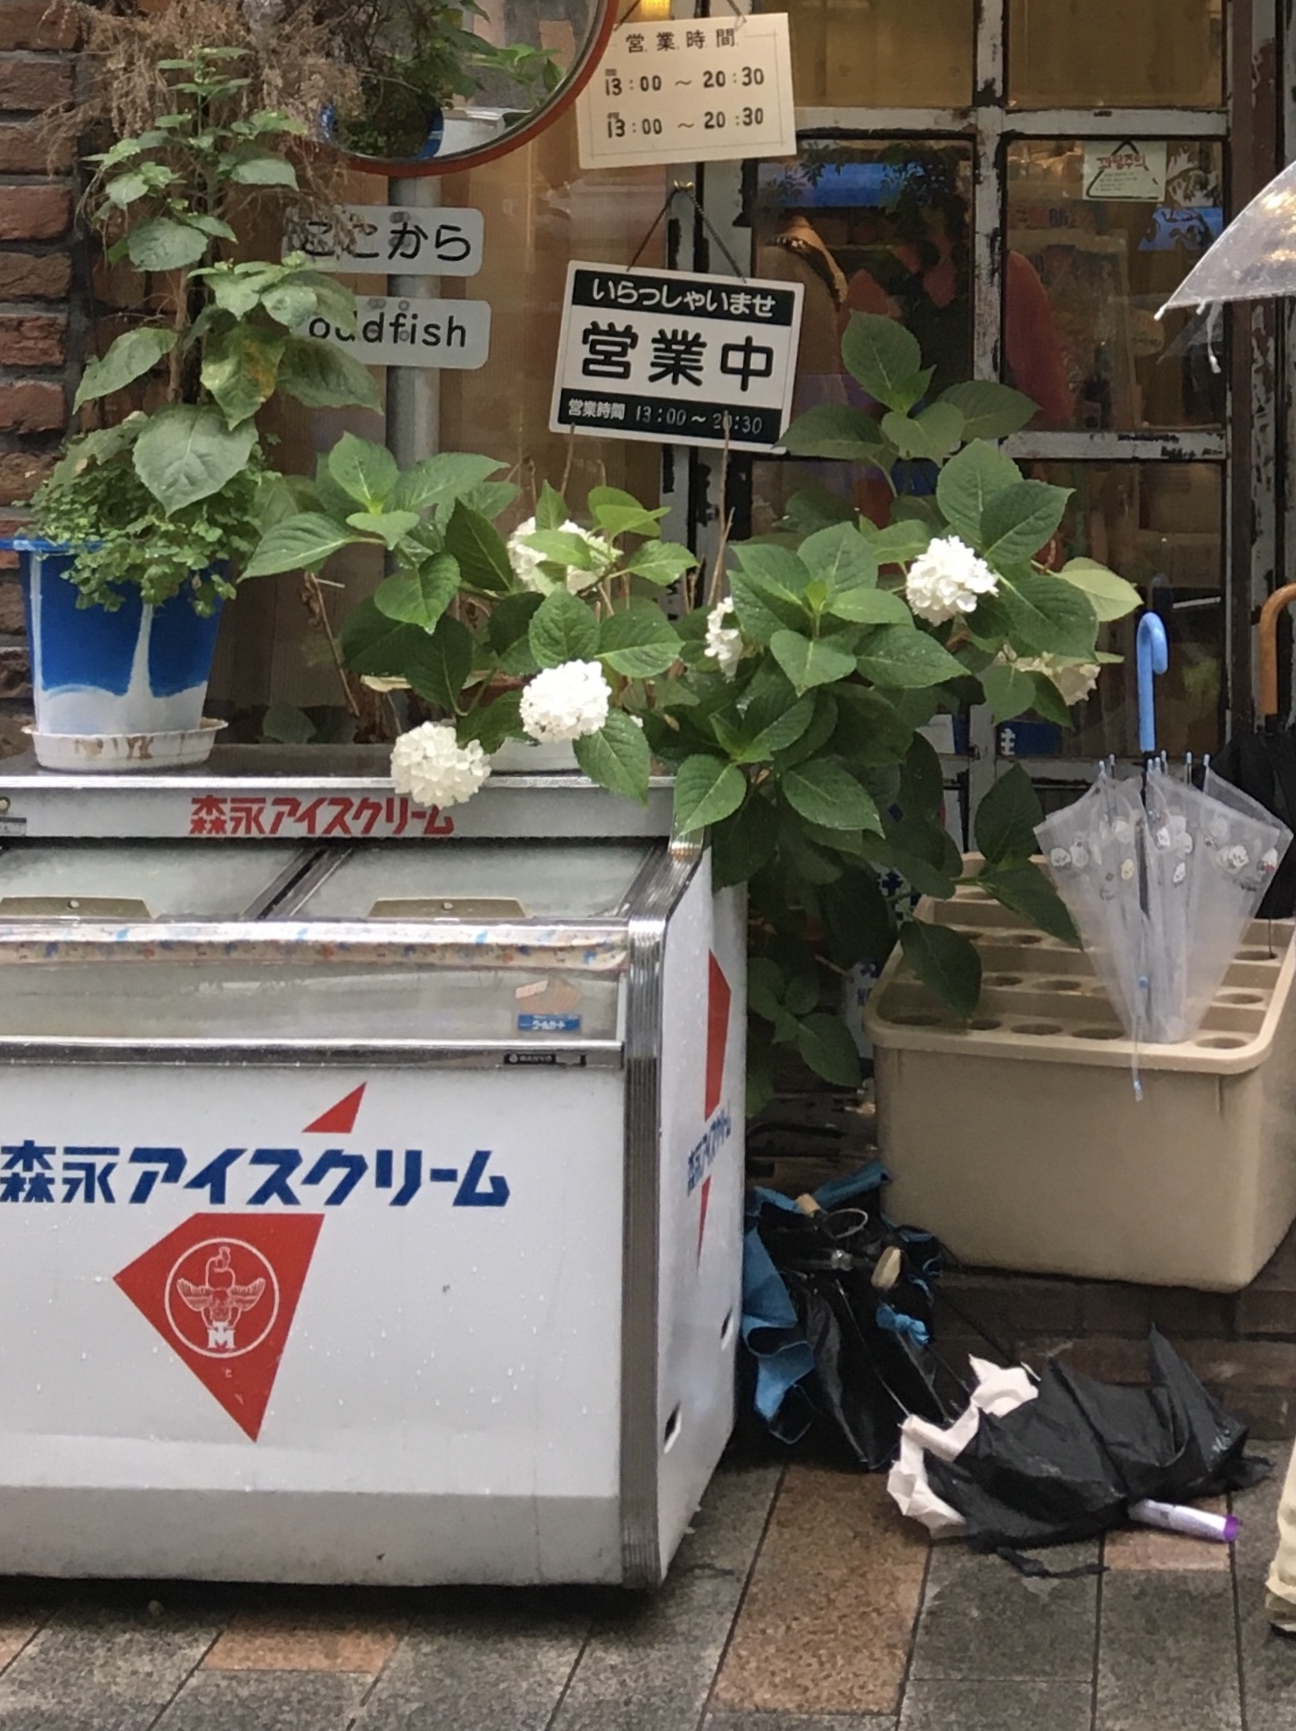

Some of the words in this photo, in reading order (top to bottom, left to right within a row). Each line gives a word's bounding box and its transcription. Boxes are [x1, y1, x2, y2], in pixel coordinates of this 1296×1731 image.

[626, 28, 736, 53] 営業時間
[703, 66, 764, 88] 20:30
[704, 107, 764, 129] 20:30
[302, 222, 471, 261] ここから
[592, 278, 776, 317] いらっしゃいませ
[582, 320, 774, 392] 営業中
[568, 398, 625, 420] 営業時間
[189, 794, 454, 835] 森永アイスクリーム
[0, 1139, 510, 1207] 森永アイスクリーム
